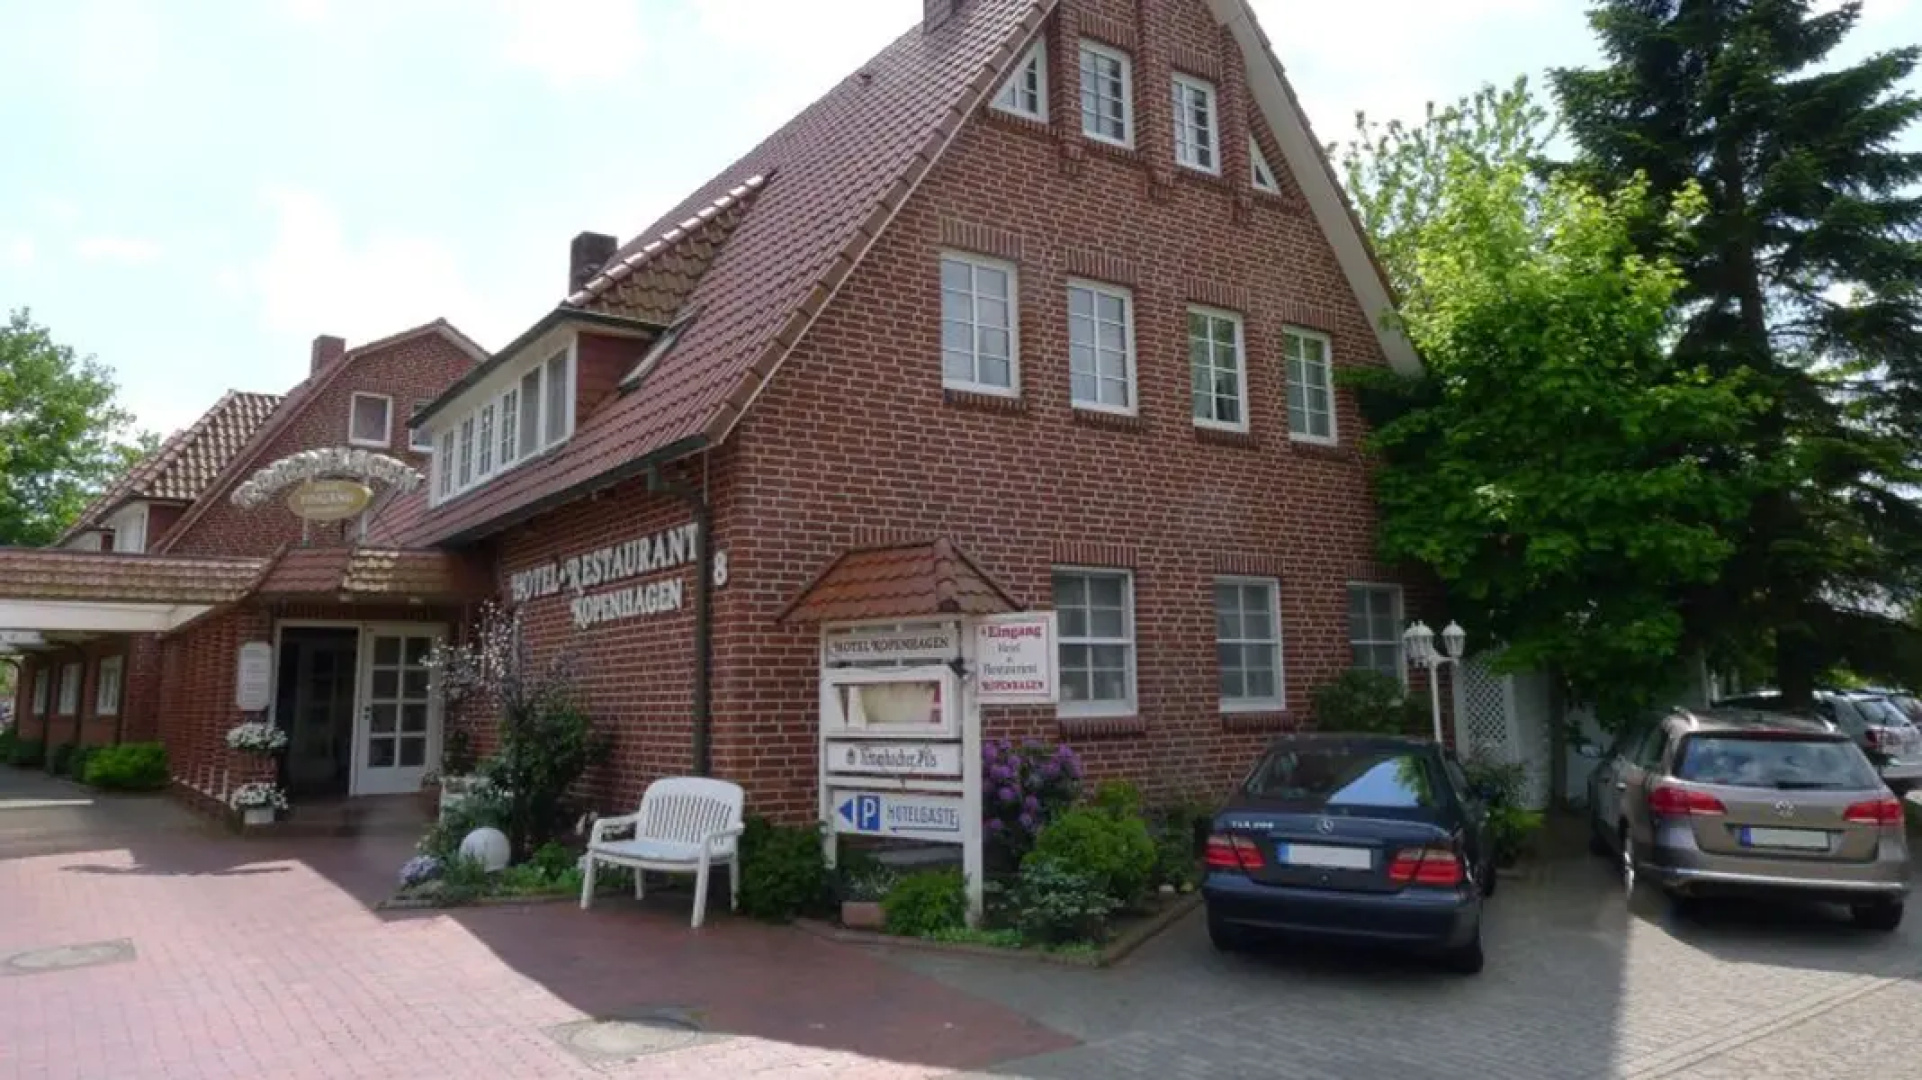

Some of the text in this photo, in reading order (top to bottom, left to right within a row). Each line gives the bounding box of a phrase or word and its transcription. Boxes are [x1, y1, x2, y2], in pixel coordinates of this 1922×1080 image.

[713, 550, 728, 586] 8
[571, 578, 683, 629] KOPENHAGEN
[987, 626, 1042, 639] Eingang
[863, 798, 877, 828] P
